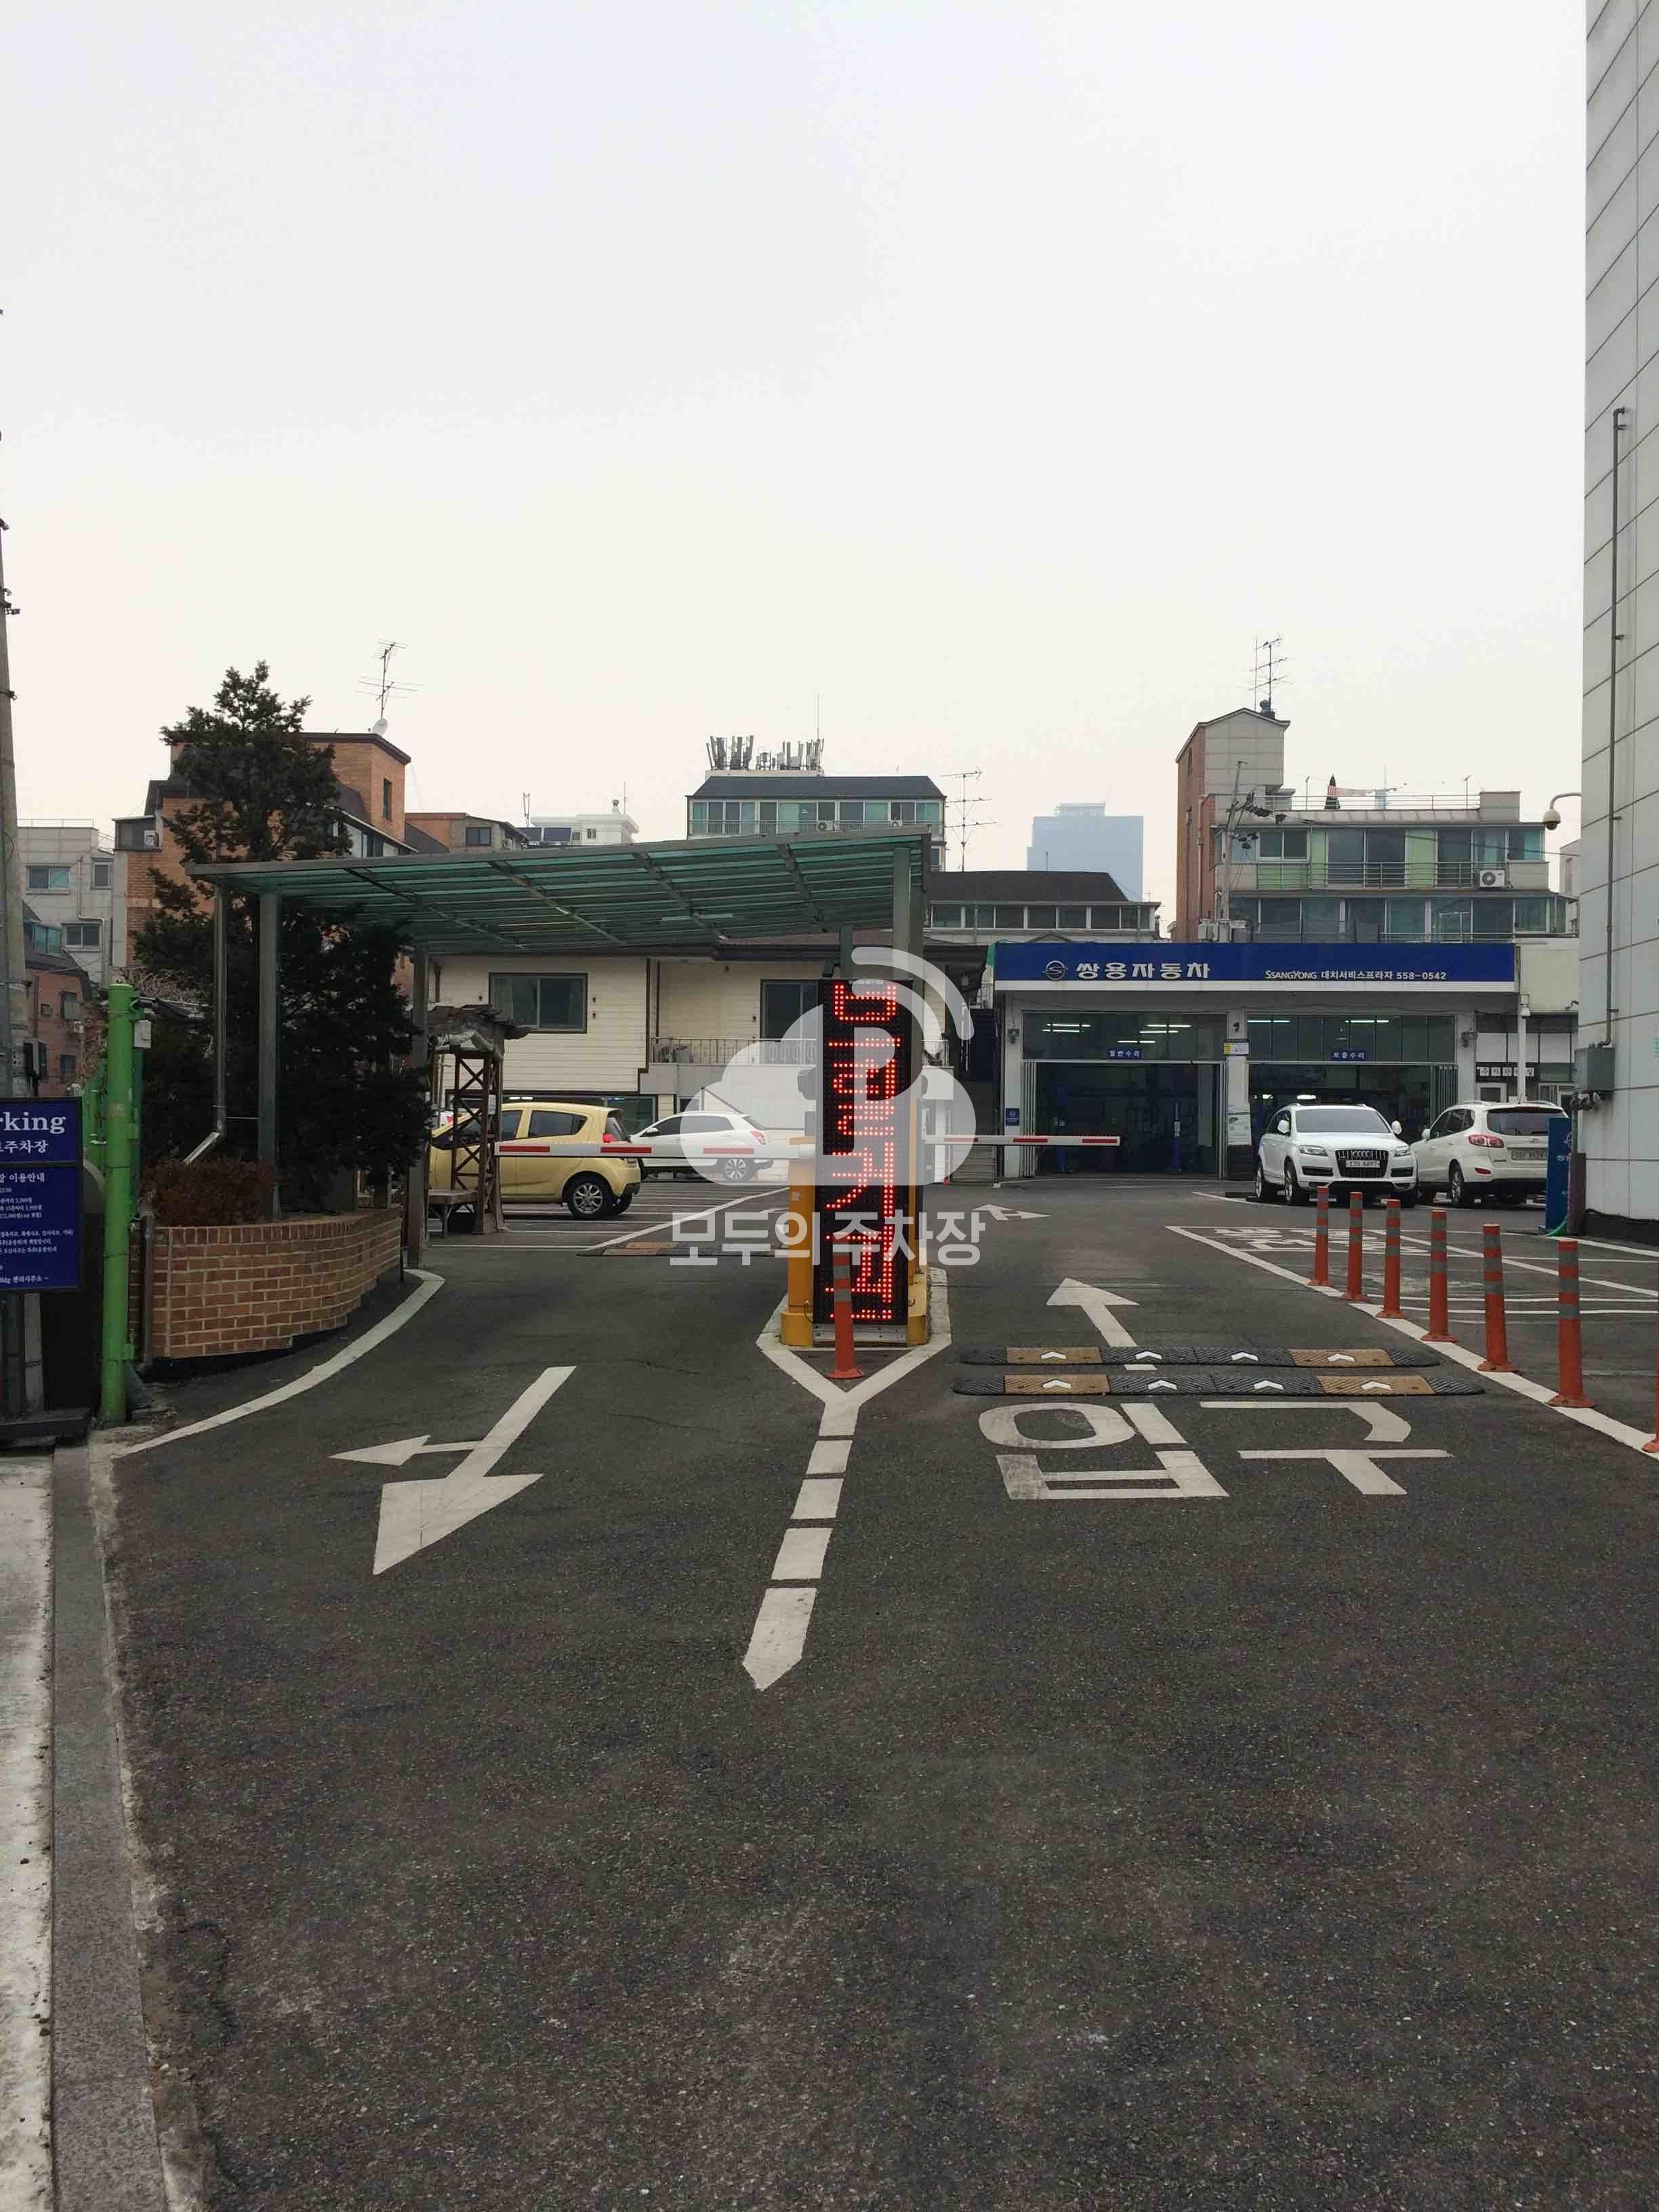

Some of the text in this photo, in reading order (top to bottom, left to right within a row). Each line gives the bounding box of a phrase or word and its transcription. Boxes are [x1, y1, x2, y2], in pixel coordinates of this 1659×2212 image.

[1076, 962, 1210, 979] 쌍용자동차
[1321, 970, 1393, 980] 대치서비스프라자
[1396, 972, 1447, 980] 558-0542
[9, 1172, 45, 1183] 이용안내
[978, 1401, 1454, 1500] 입구
